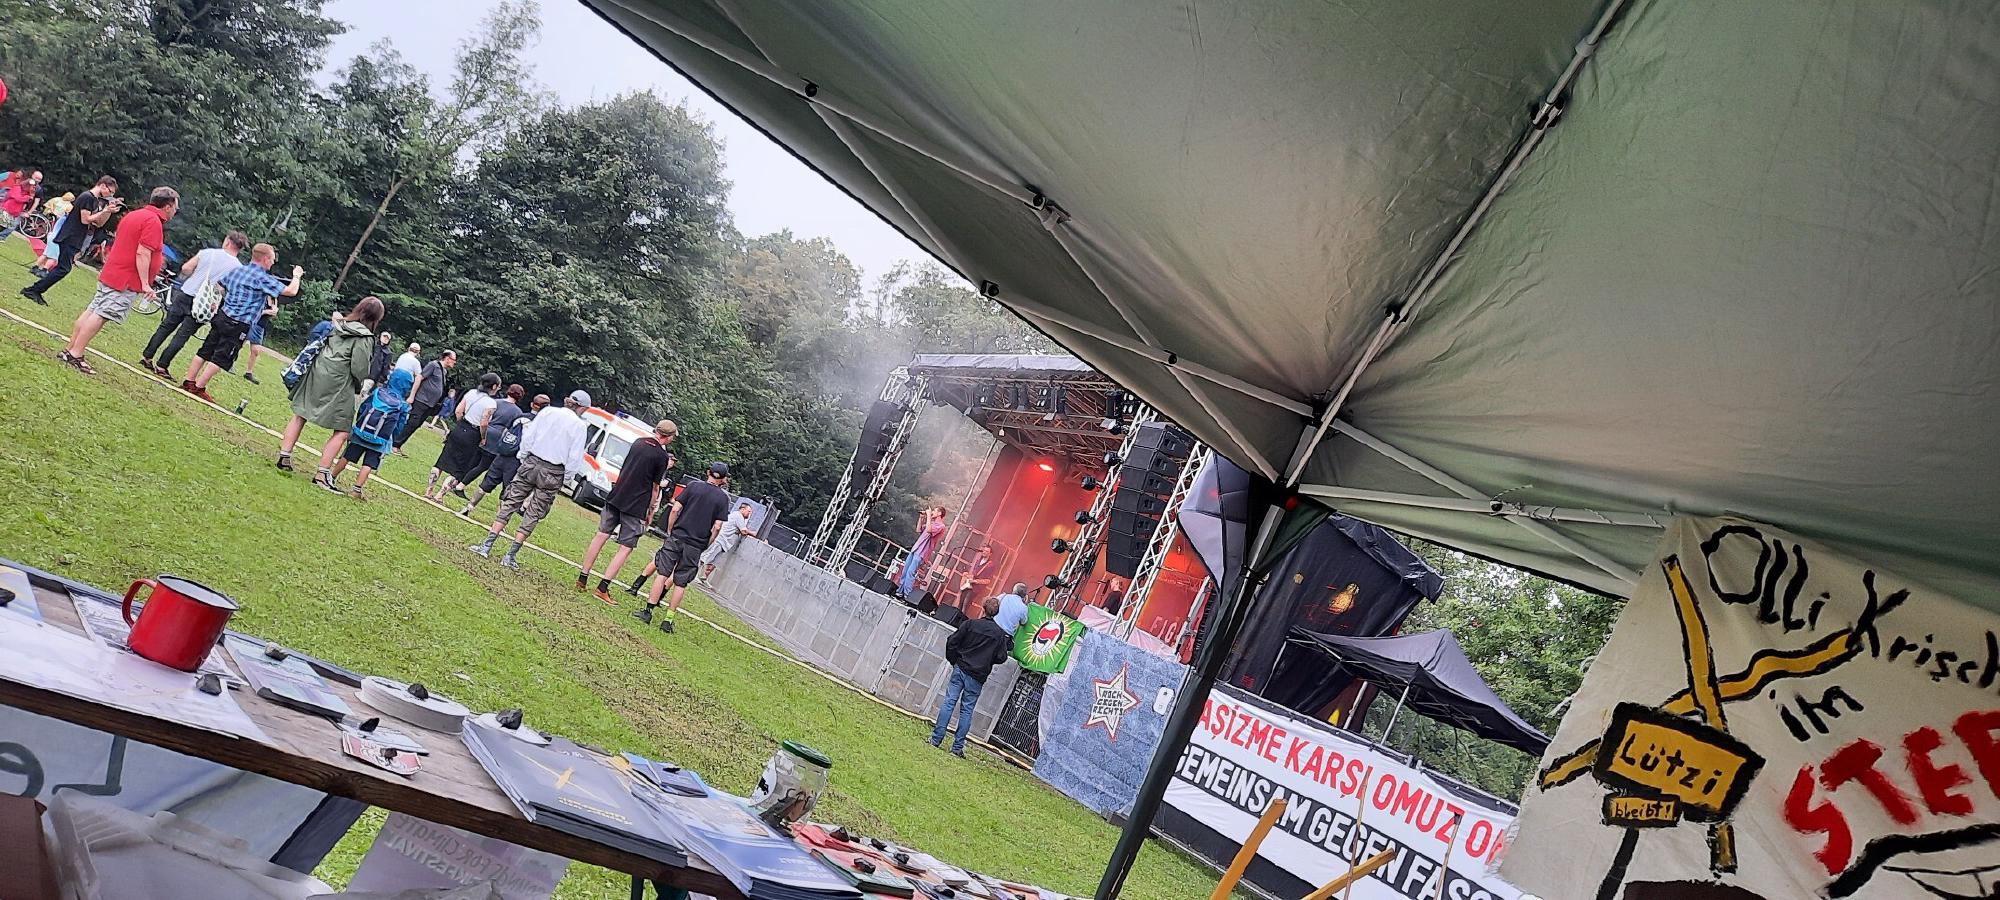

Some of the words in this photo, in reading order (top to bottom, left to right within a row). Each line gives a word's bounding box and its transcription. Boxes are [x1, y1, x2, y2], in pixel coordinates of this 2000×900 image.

[1150, 616, 1178, 644] FIG
[1092, 705, 1125, 716] RECHTS
[1096, 699, 1123, 707] GEGEN
[1620, 733, 1723, 795] Lützi
[1372, 774, 1466, 844] OMUZ
[1615, 800, 1672, 818] bleibt!
[1307, 808, 1409, 884] GEGEN
